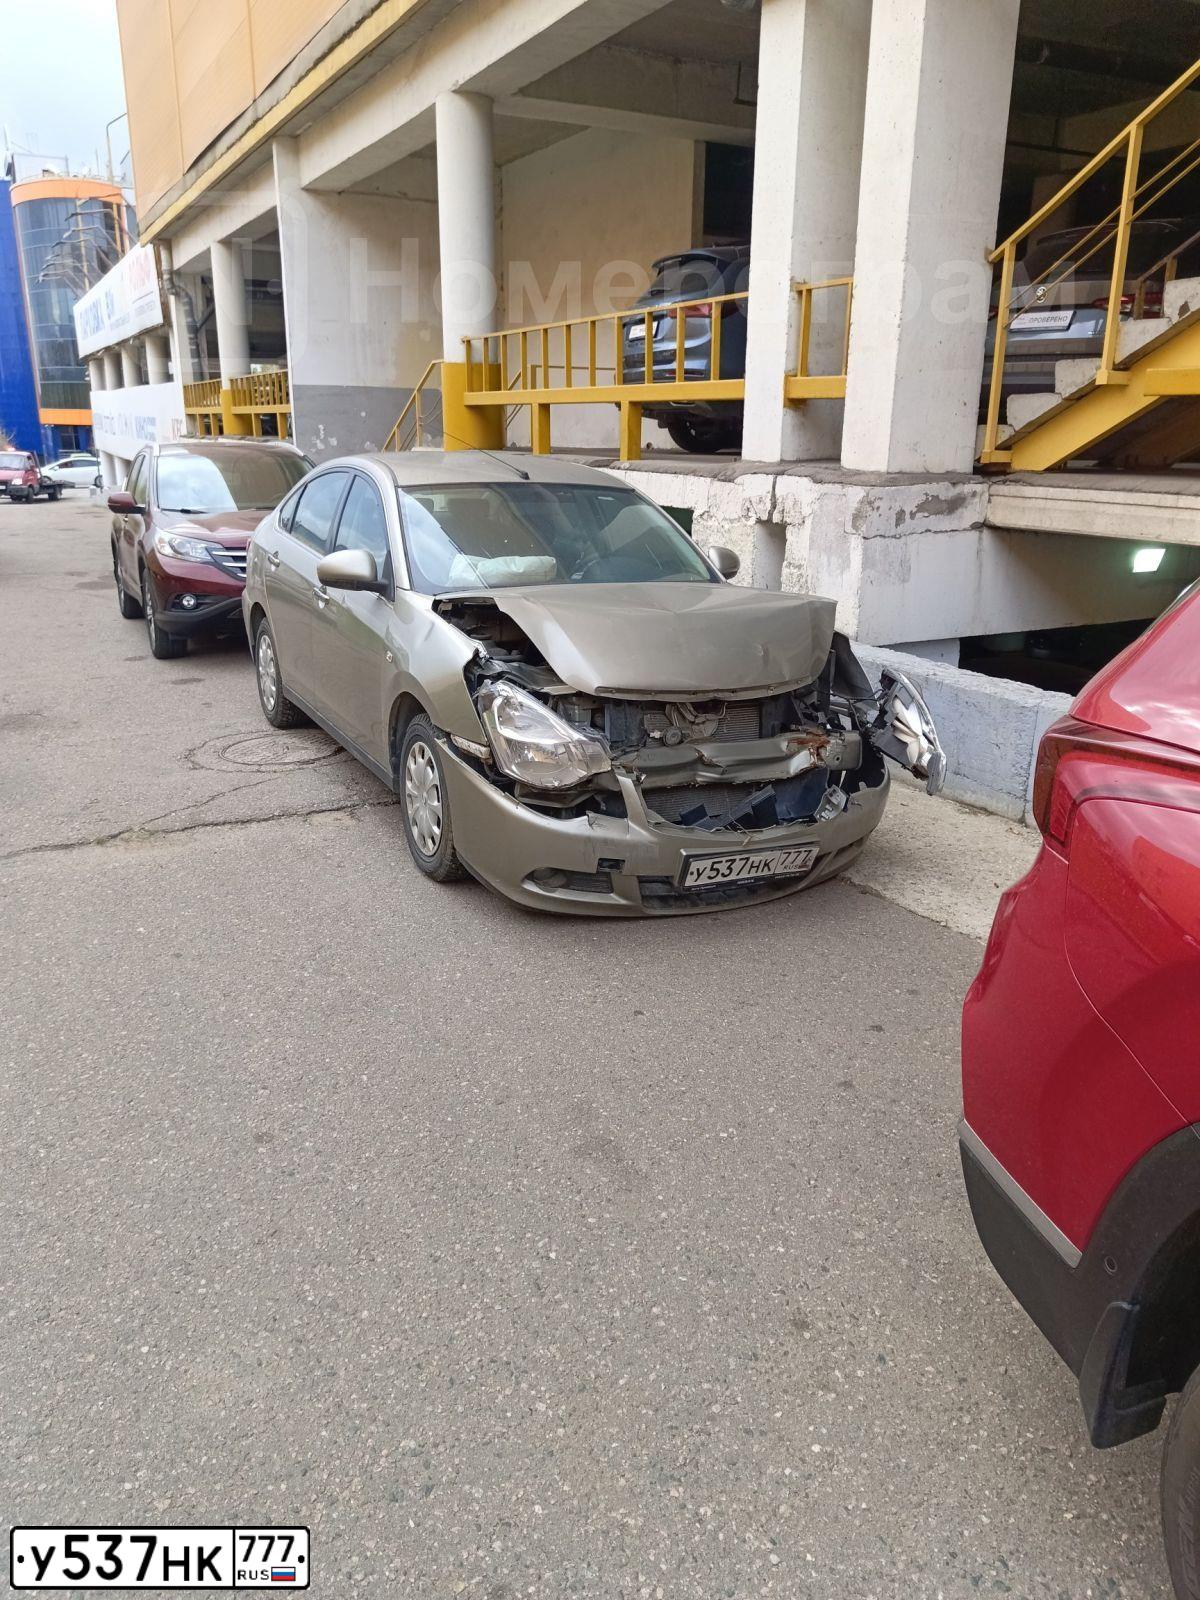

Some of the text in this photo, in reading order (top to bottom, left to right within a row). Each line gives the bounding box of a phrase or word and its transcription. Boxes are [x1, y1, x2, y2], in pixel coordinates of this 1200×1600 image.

[1028, 315, 1068, 324] ПРОВЕРЕНО
[695, 857, 775, 882] У537НК
[782, 850, 813, 865] 777
